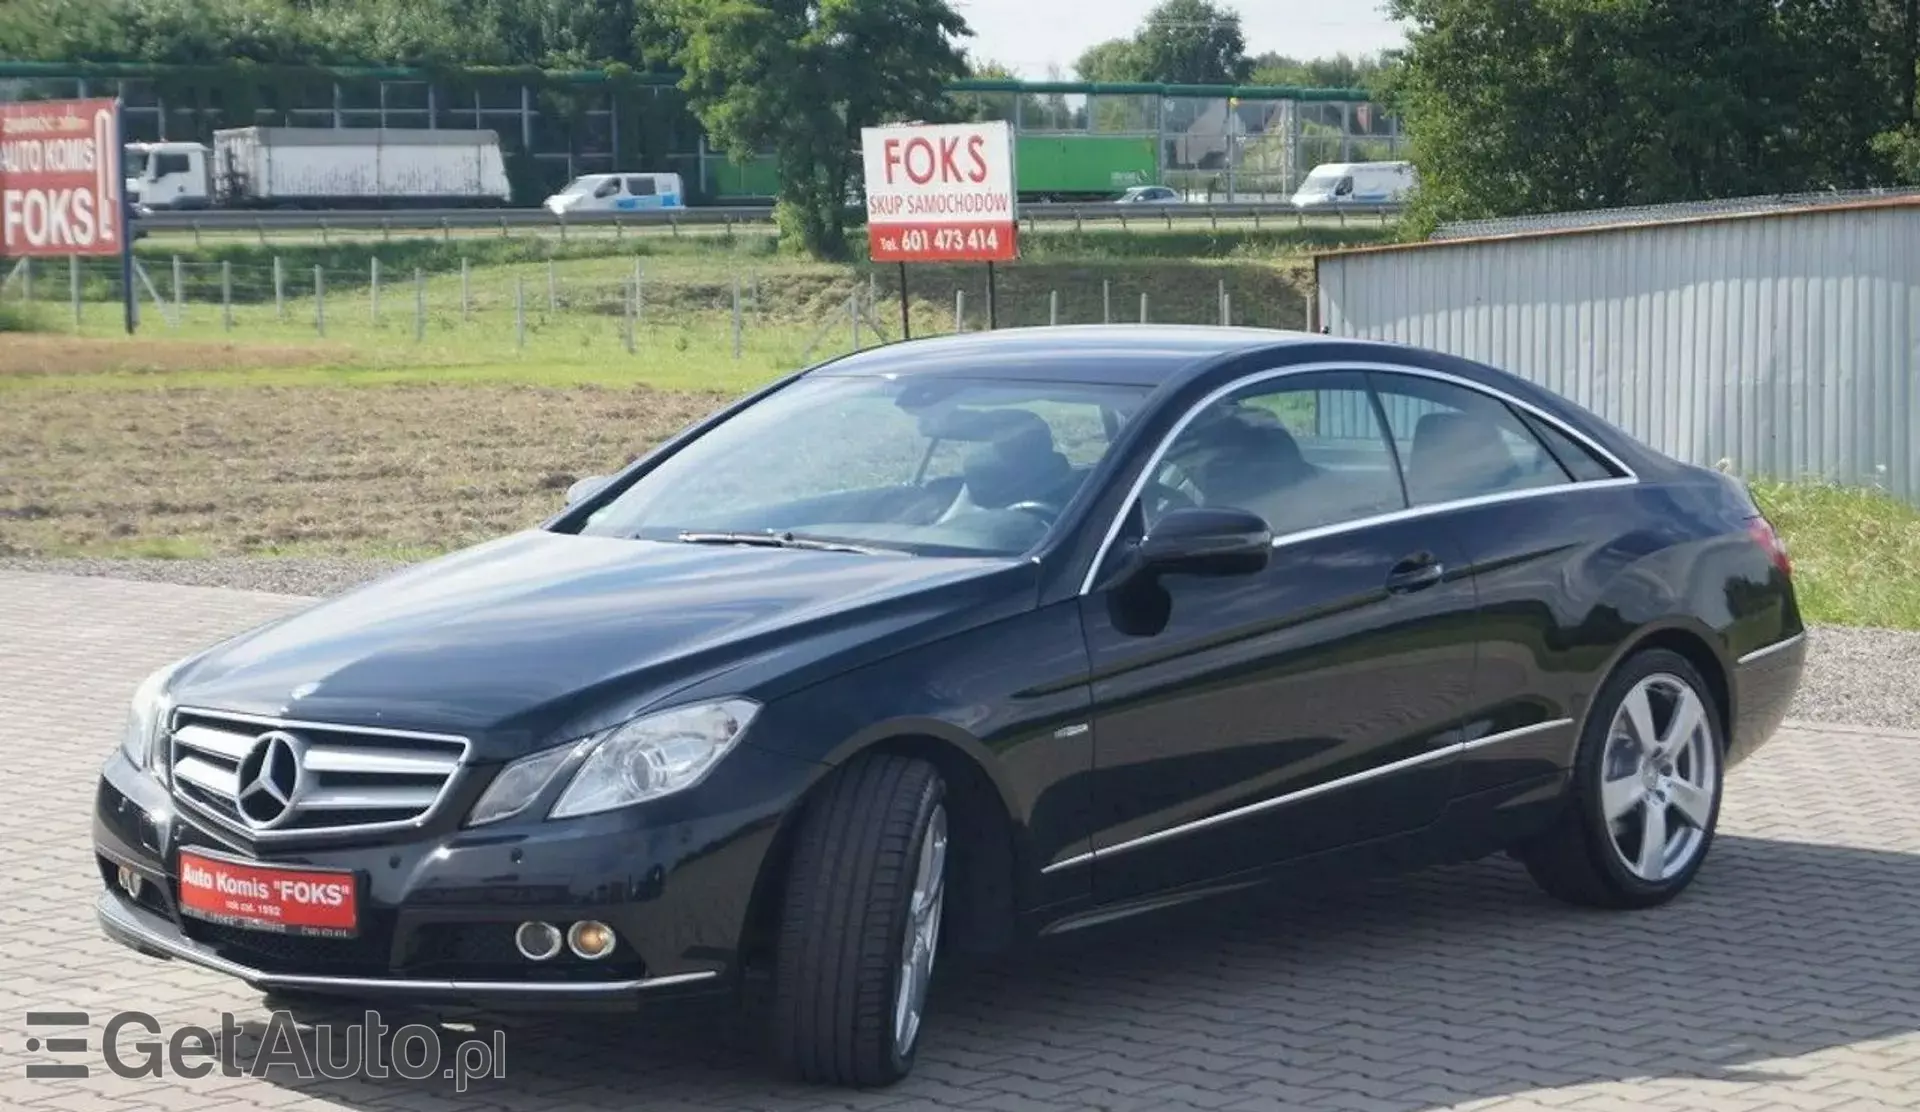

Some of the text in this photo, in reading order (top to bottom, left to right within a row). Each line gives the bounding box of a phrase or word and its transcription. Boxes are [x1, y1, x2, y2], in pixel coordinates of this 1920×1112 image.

[44, 138, 95, 171] KOMIS
[884, 135, 987, 185] FOKS
[3, 187, 95, 246] FOKS
[870, 187, 1007, 215] SKUP SAMOCHODÓW
[879, 228, 998, 251] Tel. 601 473 414
[182, 863, 351, 907] Auto Komis "FOKS"
